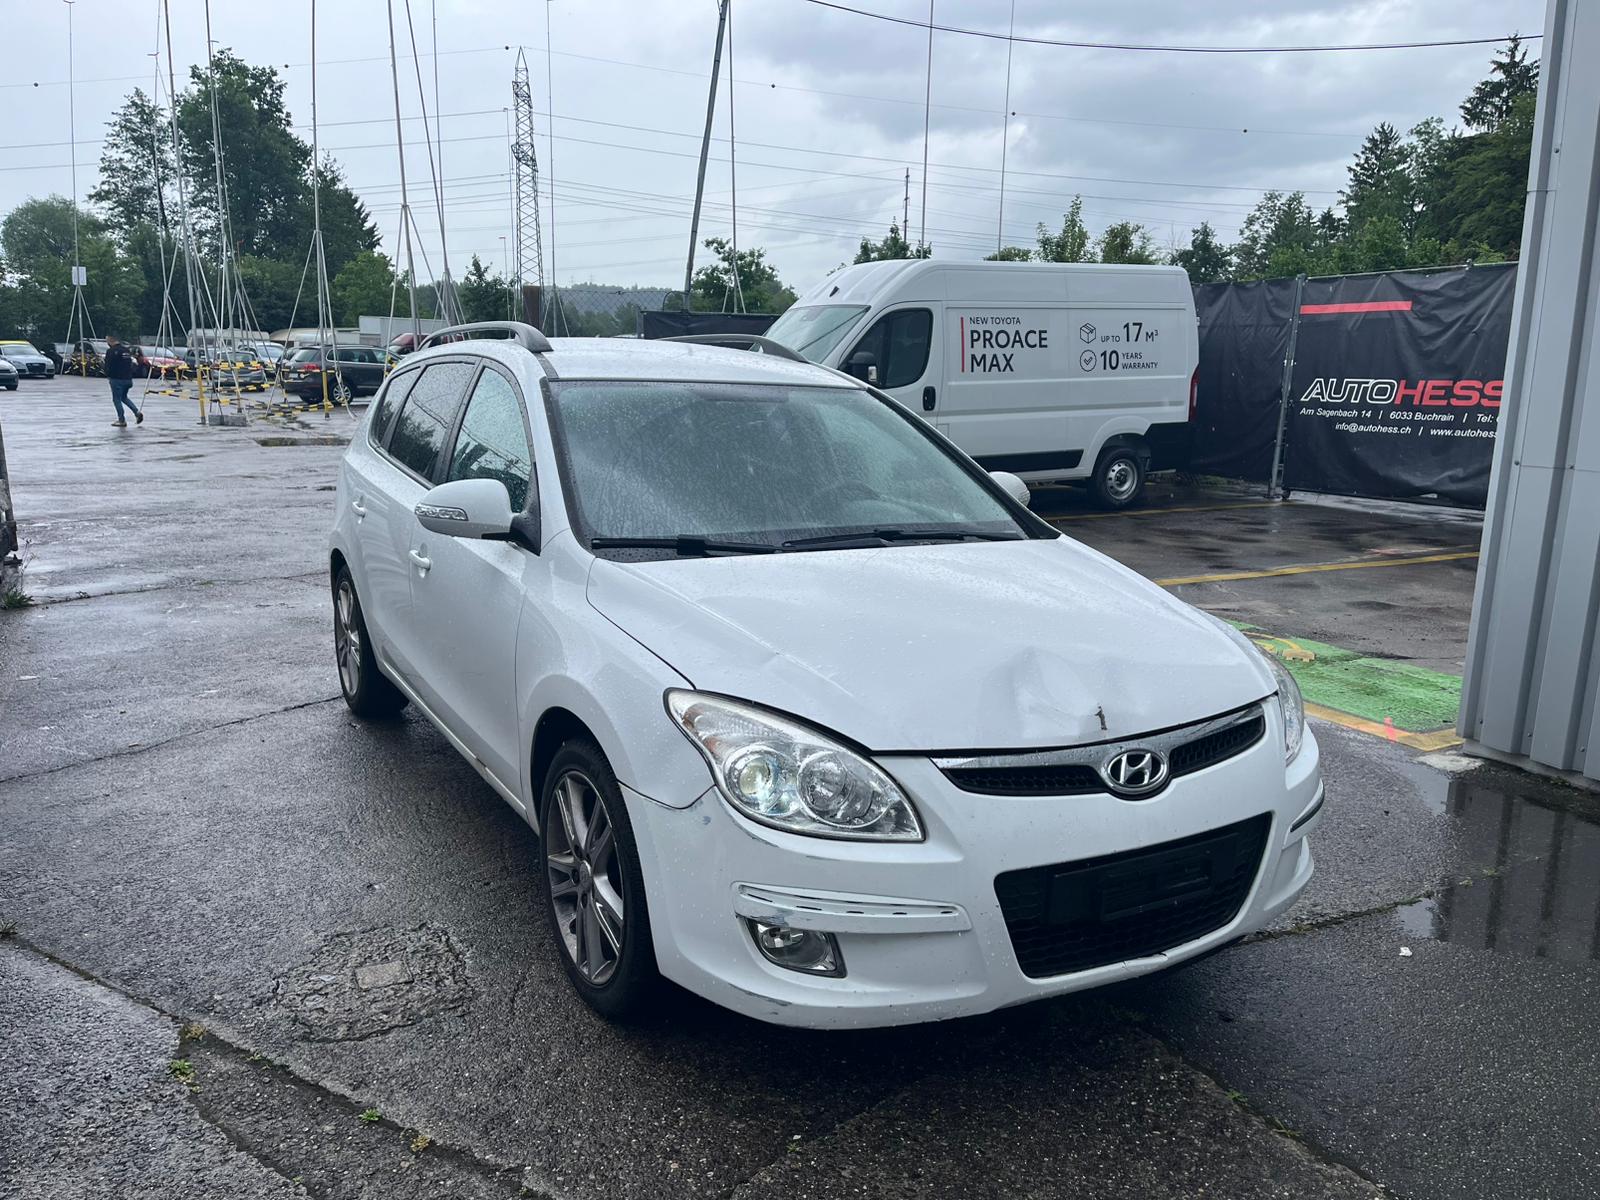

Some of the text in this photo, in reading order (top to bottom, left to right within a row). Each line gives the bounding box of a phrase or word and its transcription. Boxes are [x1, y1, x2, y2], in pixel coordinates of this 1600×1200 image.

[969, 316, 1021, 325] NEW TOYOTA
[970, 330, 1048, 348] PROACE
[1122, 322, 1143, 342] 17
[970, 354, 1014, 372] MAX
[1100, 350, 1120, 370] 10
[1122, 362, 1158, 370] WARRANTY
[1390, 412, 1413, 420] 6033
[1414, 412, 1454, 422] Buchrain
[1476, 414, 1494, 423] Tel:
[1335, 422, 1411, 434] info@autohess.ch
